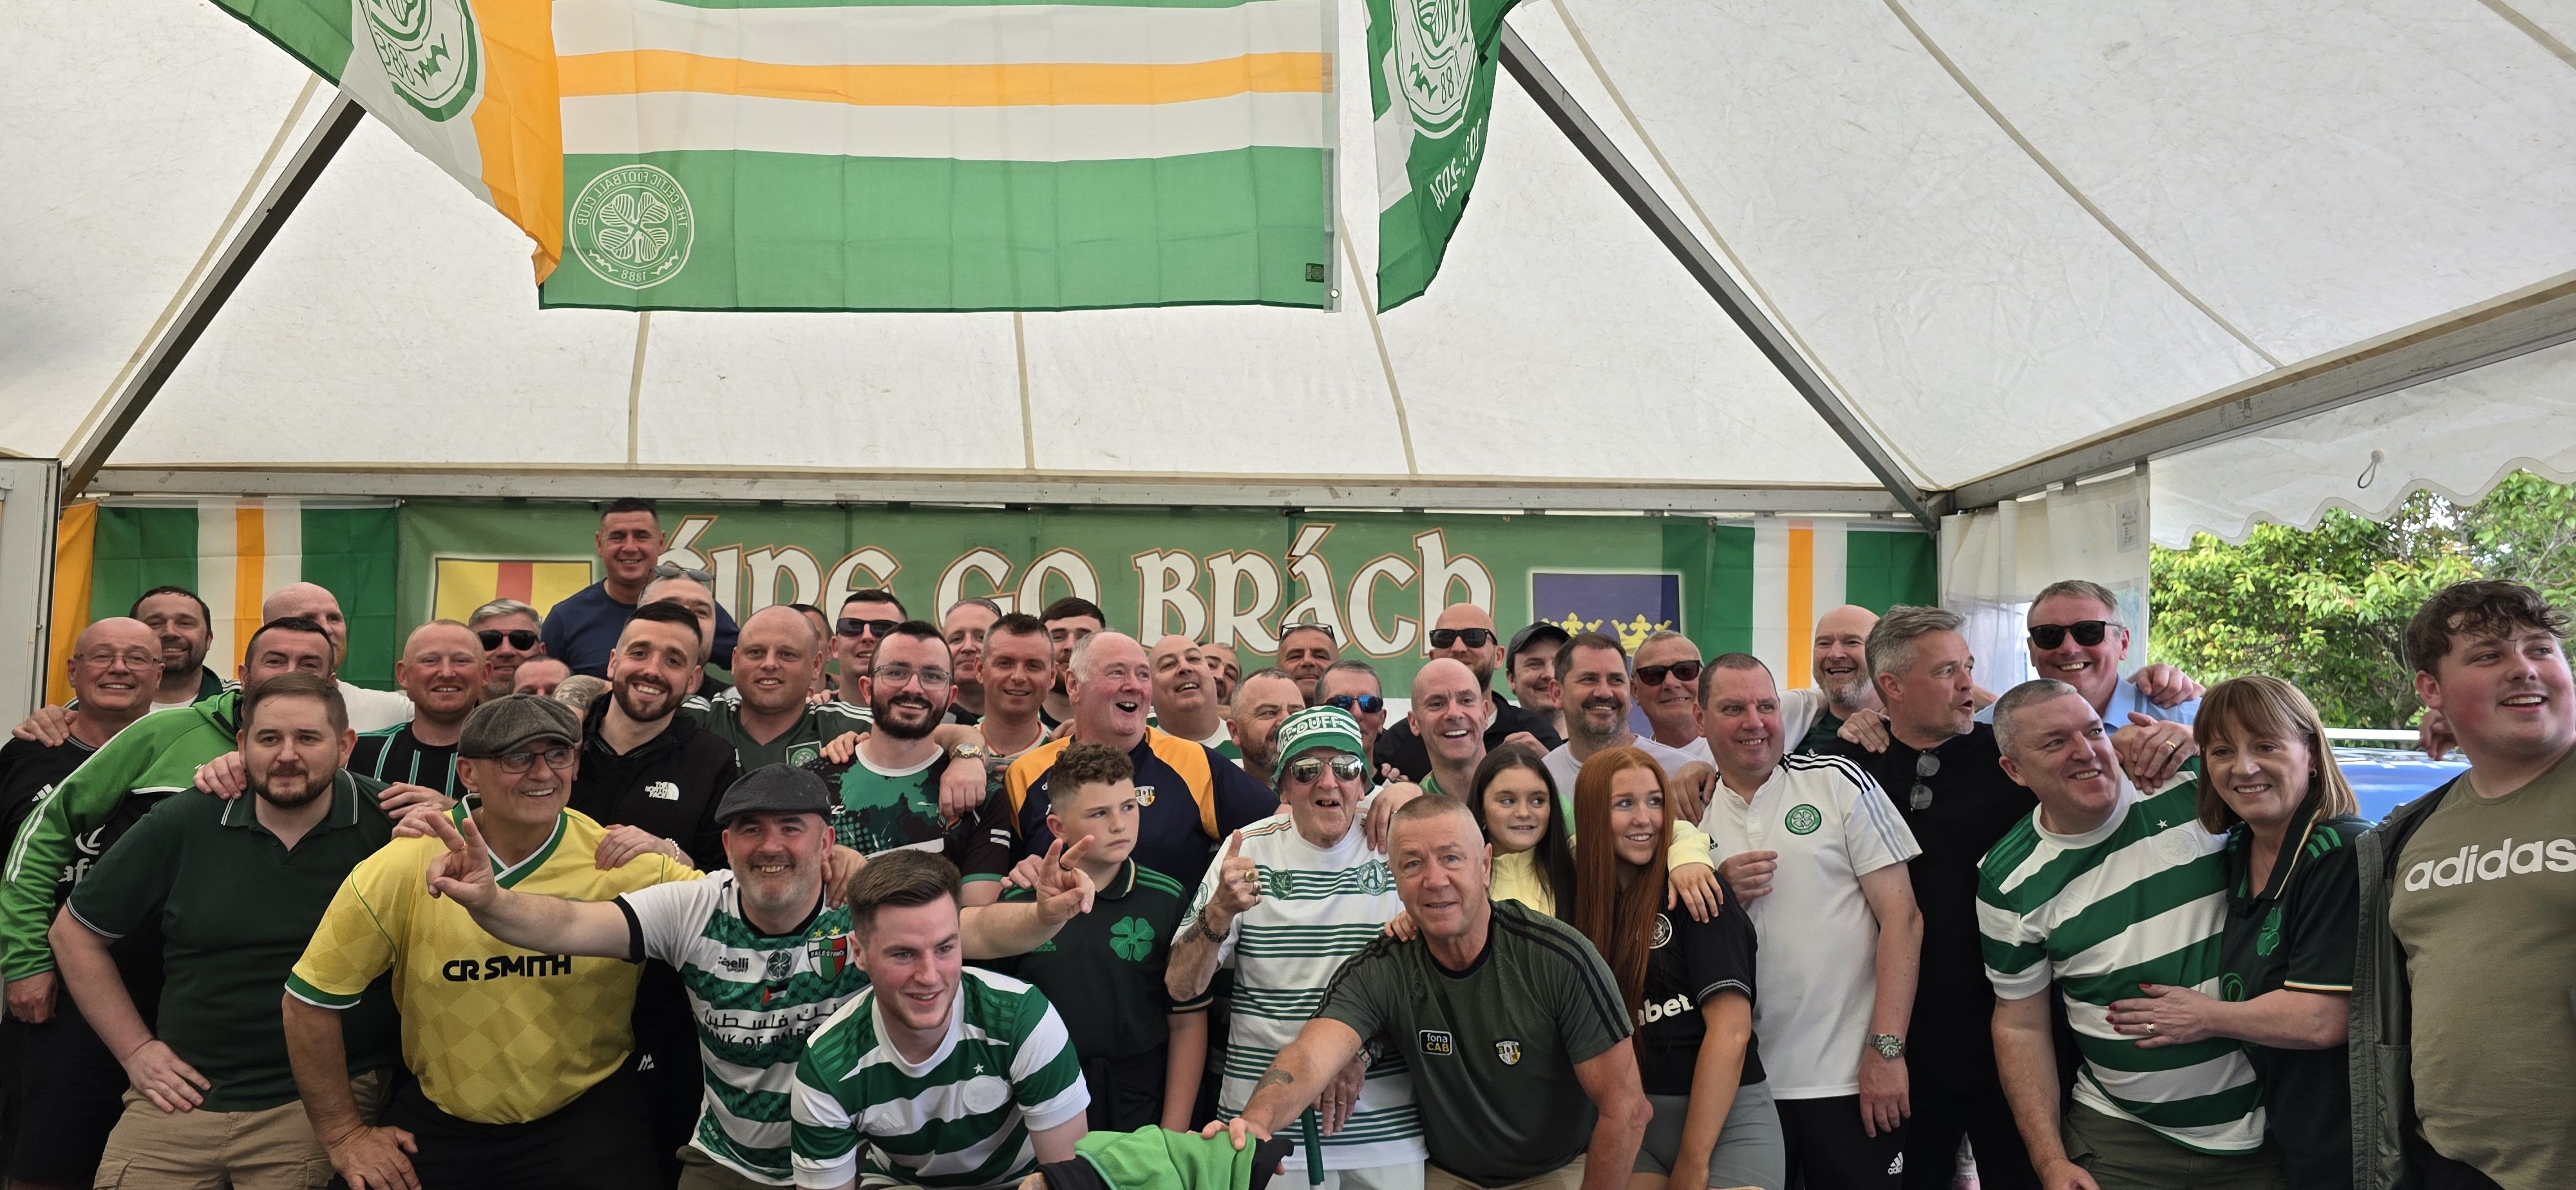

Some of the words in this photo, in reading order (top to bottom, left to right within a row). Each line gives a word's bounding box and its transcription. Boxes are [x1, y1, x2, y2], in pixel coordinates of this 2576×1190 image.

[2405, 838, 2576, 892] adidas
[442, 959, 480, 981] CR
[484, 954, 571, 981] SMITH
[742, 1035, 764, 1051] OF
[1426, 1032, 1448, 1043] fona
[1426, 1042, 1450, 1052] CAB
